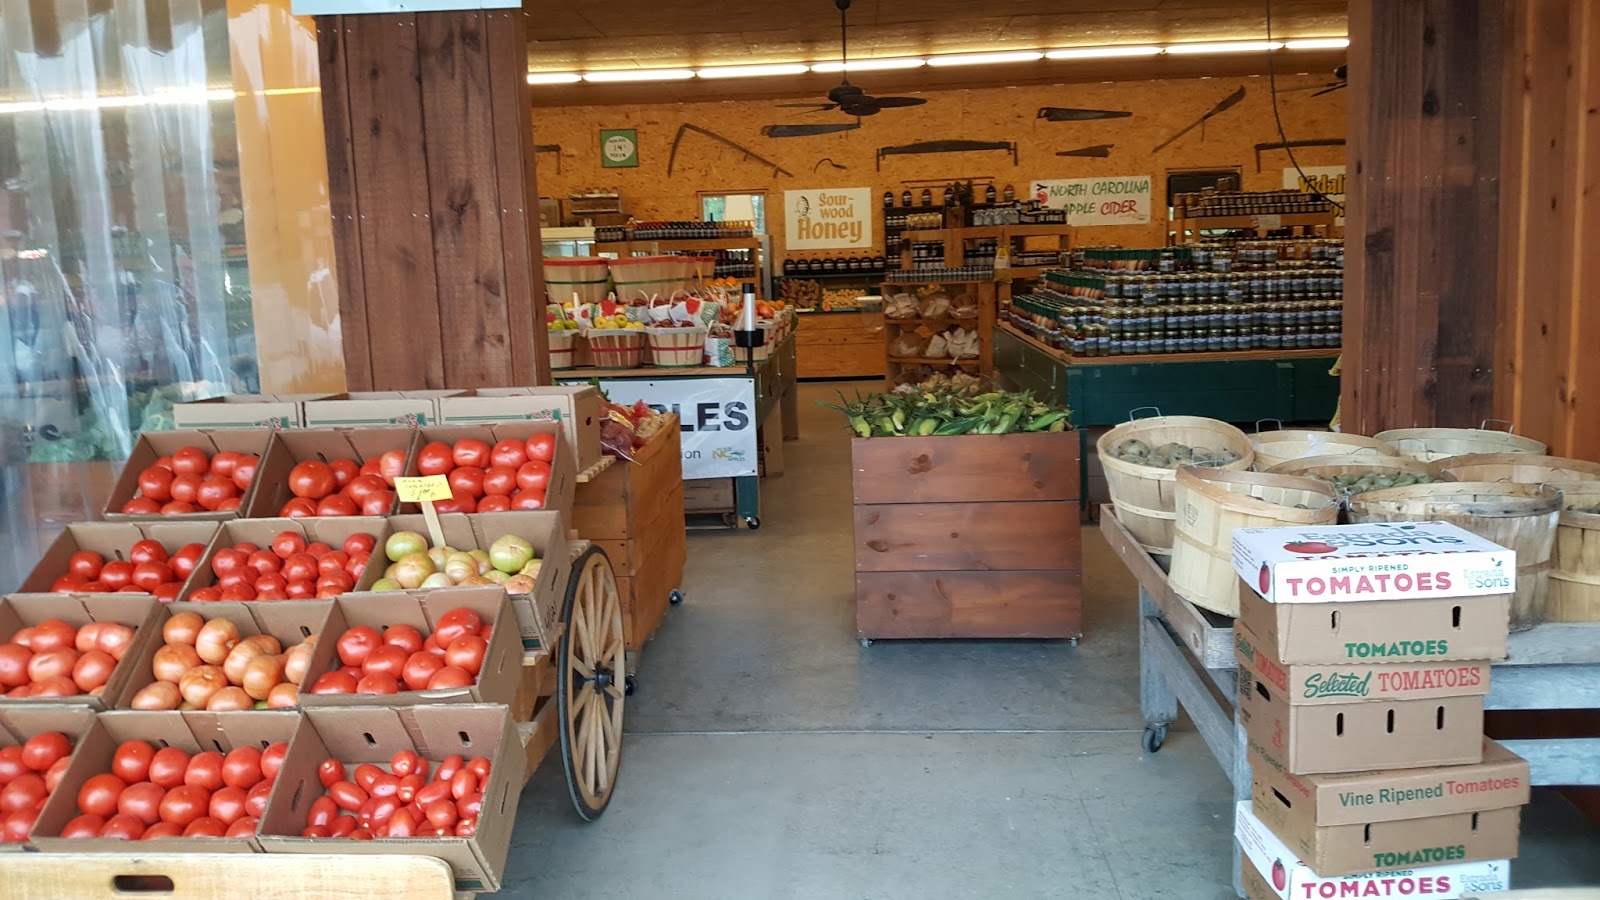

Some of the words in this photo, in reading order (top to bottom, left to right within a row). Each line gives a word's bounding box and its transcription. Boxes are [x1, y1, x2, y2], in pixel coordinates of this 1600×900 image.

[1050, 183, 1087, 197] NORTH
[1092, 179, 1149, 196] CAROLINA
[1298, 173, 1344, 194] Vidal
[818, 192, 854, 206] Sour-
[1063, 202, 1096, 215] APPLE
[1100, 200, 1137, 215] CIDER
[820, 204, 854, 218] wood
[797, 216, 862, 243] Honey
[1369, 564, 1408, 572] RIPENED
[1286, 572, 1452, 596] TOMATOES
[1345, 639, 1448, 658] TOMATOES
[1303, 670, 1372, 699] Selected
[1378, 667, 1481, 692] TOMATOES
[1339, 792, 1374, 807] Vine
[1379, 783, 1443, 805] Ripened
[1446, 777, 1520, 795] Tomatoes
[1374, 845, 1466, 867] TOMATOES
[1376, 870, 1414, 878] RIPENED
[1301, 876, 1451, 899] TOMATOES
